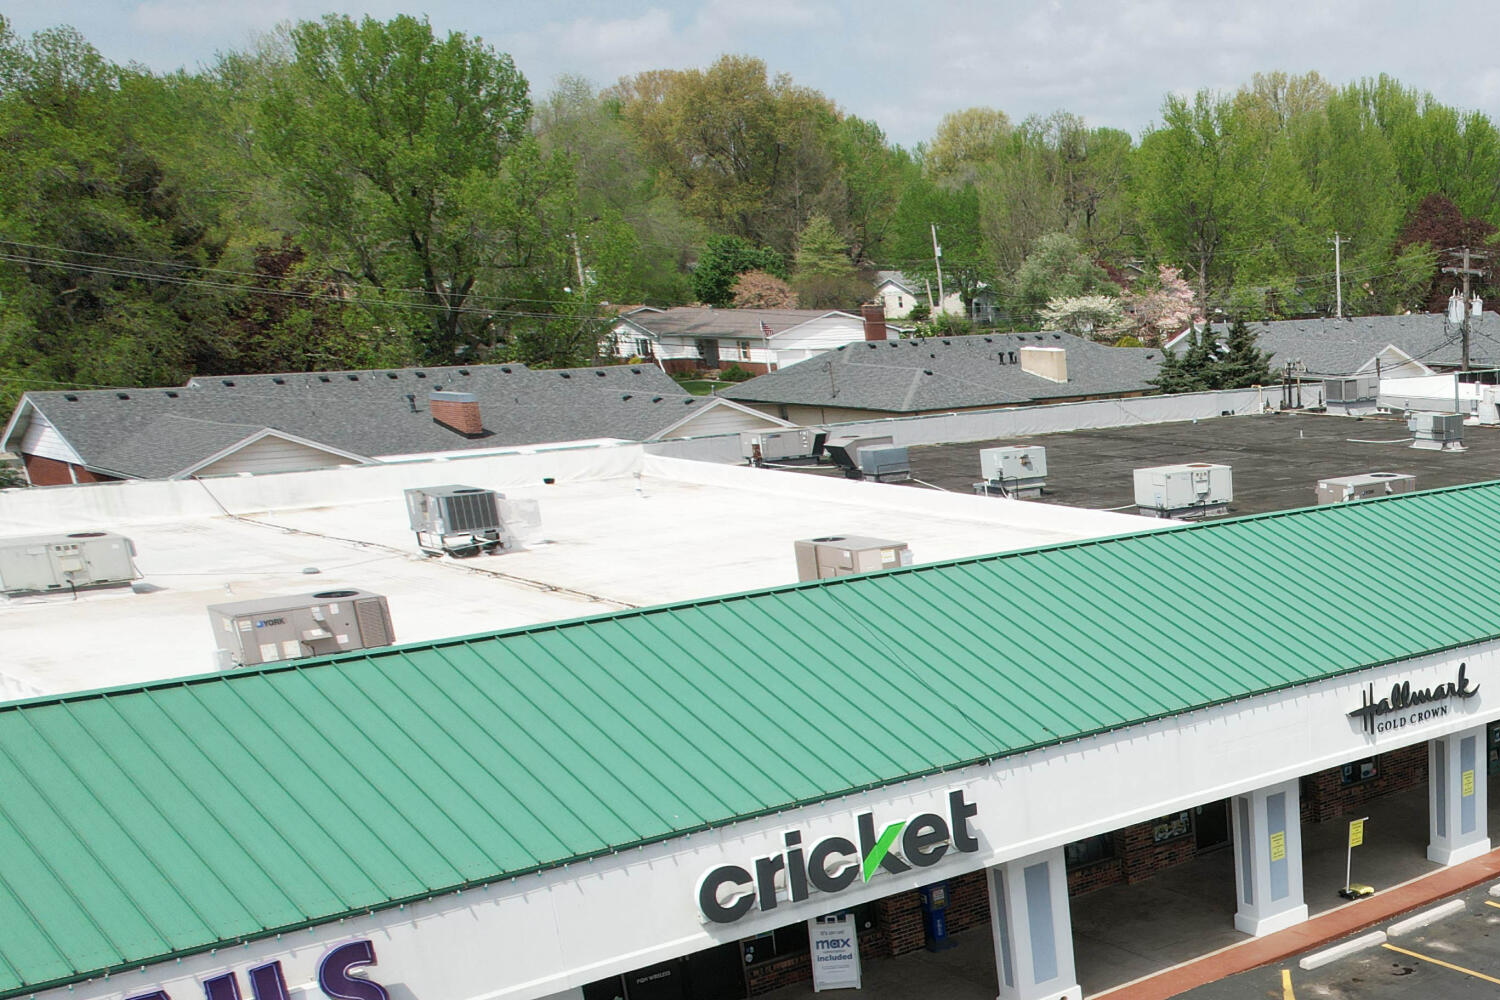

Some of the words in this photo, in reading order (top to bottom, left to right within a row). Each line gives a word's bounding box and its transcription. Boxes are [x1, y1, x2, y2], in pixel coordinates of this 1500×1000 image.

[1346, 662, 1480, 735] Hallmark
[1377, 717, 1407, 733] GOLD
[1410, 705, 1448, 724] CROWN
[696, 790, 979, 924] cricket
[816, 938, 851, 950] max
[817, 953, 853, 962] included
